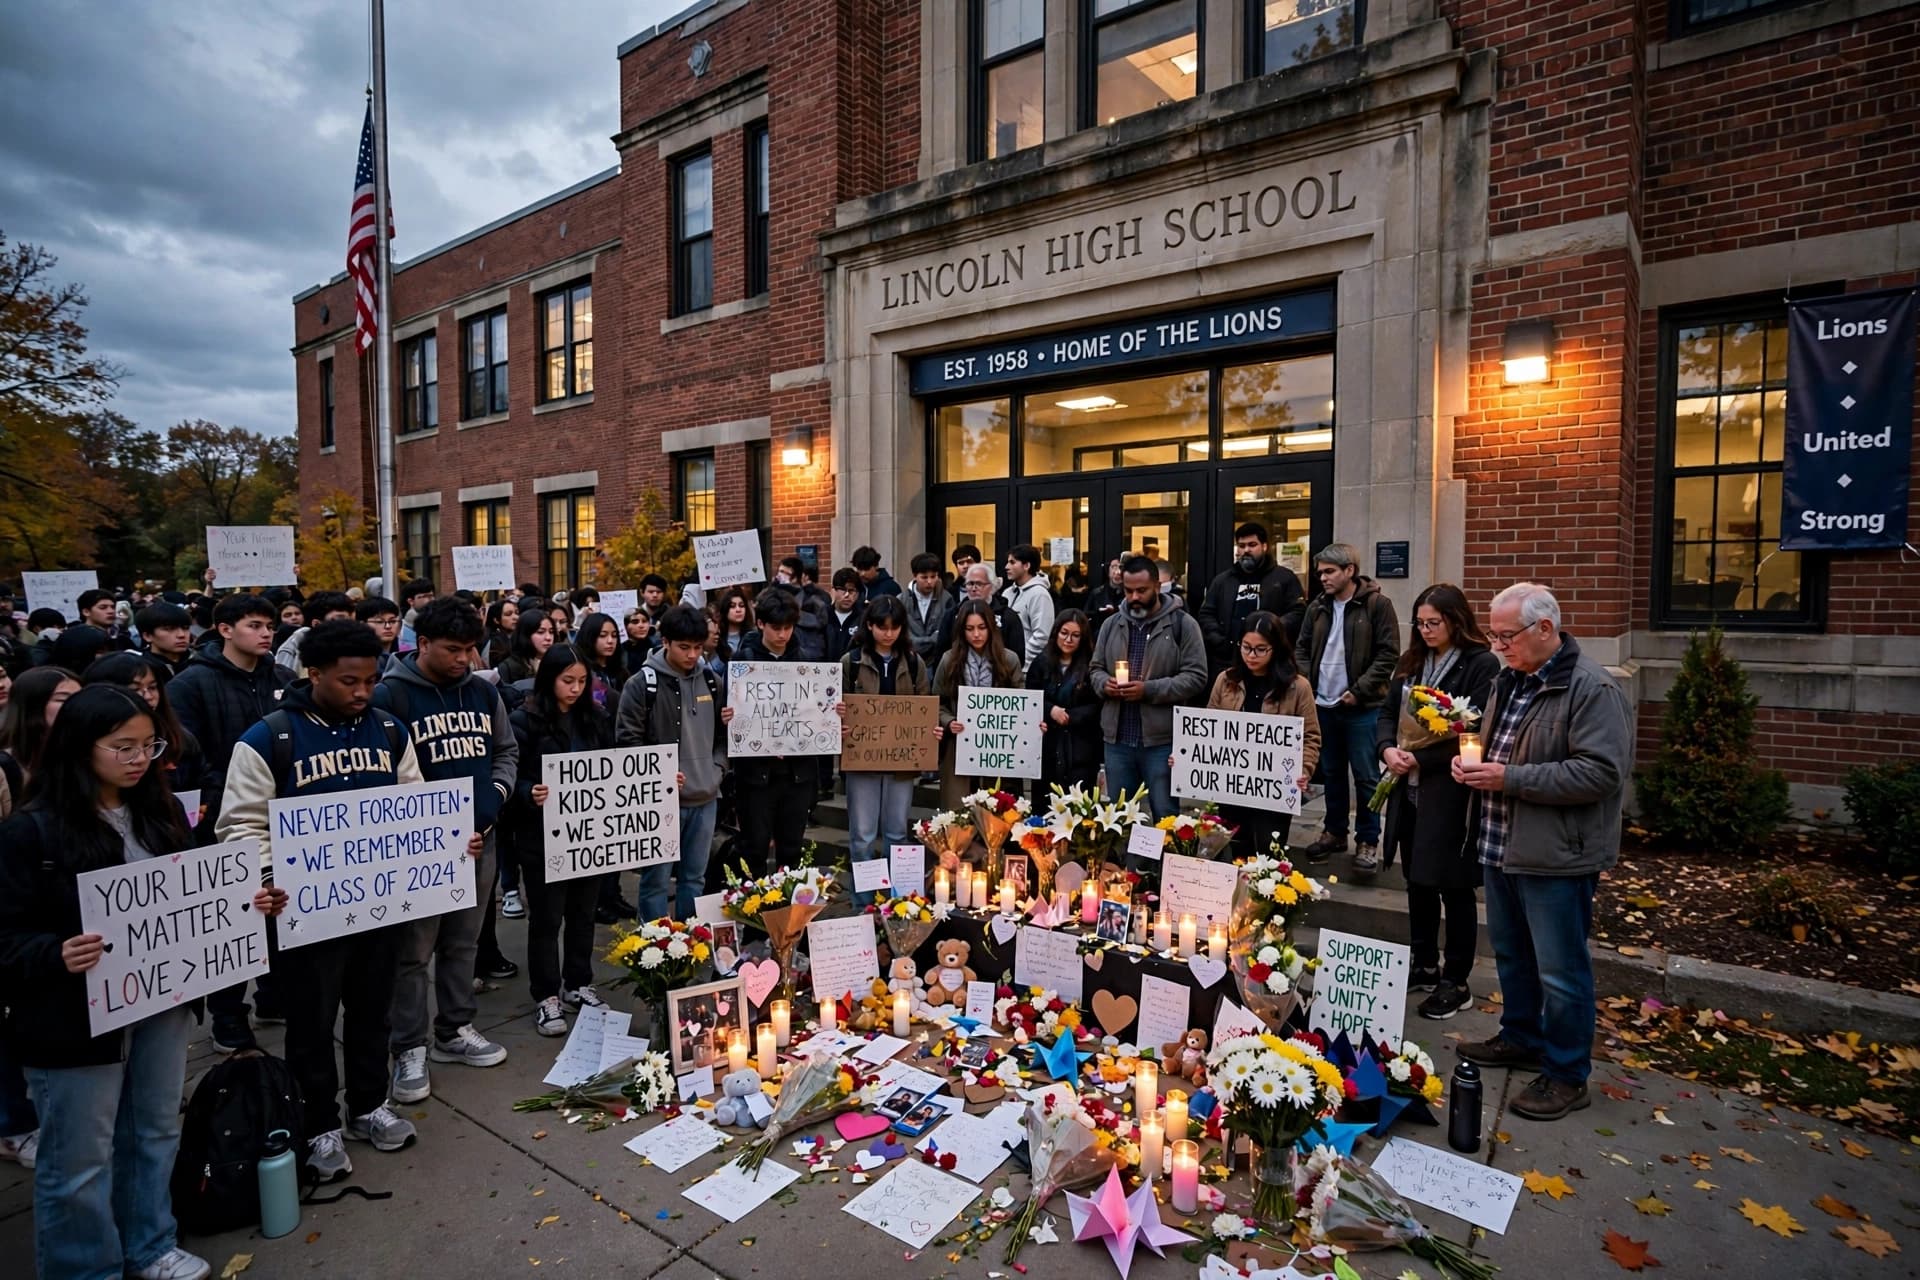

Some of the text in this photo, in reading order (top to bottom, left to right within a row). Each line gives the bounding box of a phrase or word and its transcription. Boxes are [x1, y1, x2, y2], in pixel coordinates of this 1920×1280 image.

[882, 169, 1357, 310] LINCOLN HIGH SCHOOL
[944, 306, 1283, 381] EST. 1958 HOME OF THE LIONS
[1818, 316, 1888, 341] Lions
[1803, 426, 1892, 453] United
[1800, 510, 1886, 536] Strong
[745, 681, 784, 702] REST
[967, 693, 1028, 713] SUPPORT
[411, 711, 492, 742] LINCOLN
[850, 724, 888, 742] GRIEF
[976, 713, 1018, 730] GRIEF
[1182, 716, 1292, 748] REST IN PEACE
[430, 736, 486, 764] LIONS
[974, 733, 1016, 752] UNITY
[1191, 744, 1274, 772] ALWAYS IN
[294, 748, 392, 788] LINCOLN
[558, 751, 662, 785] HOLD OUR
[978, 752, 1015, 770] HOPE
[558, 780, 662, 816] KIDS SAFE
[1190, 768, 1282, 800] OUR HEARTS
[279, 788, 461, 839] NEVER FORGOTTEN
[566, 810, 661, 844] WE STAND
[302, 831, 444, 874] WE REMEMBER
[566, 838, 664, 873] TOGETHER
[94, 851, 250, 917] YOUR LIVES
[298, 860, 456, 914] CLASS OF 2024
[127, 898, 232, 958] MATTER
[1326, 939, 1394, 970] SUPPORT
[104, 959, 172, 1014] LOVE
[204, 932, 260, 982] HATE
[1334, 964, 1382, 990] GRIEF
[1328, 984, 1376, 1014] UNITY
[1331, 1010, 1374, 1034] HOPE
